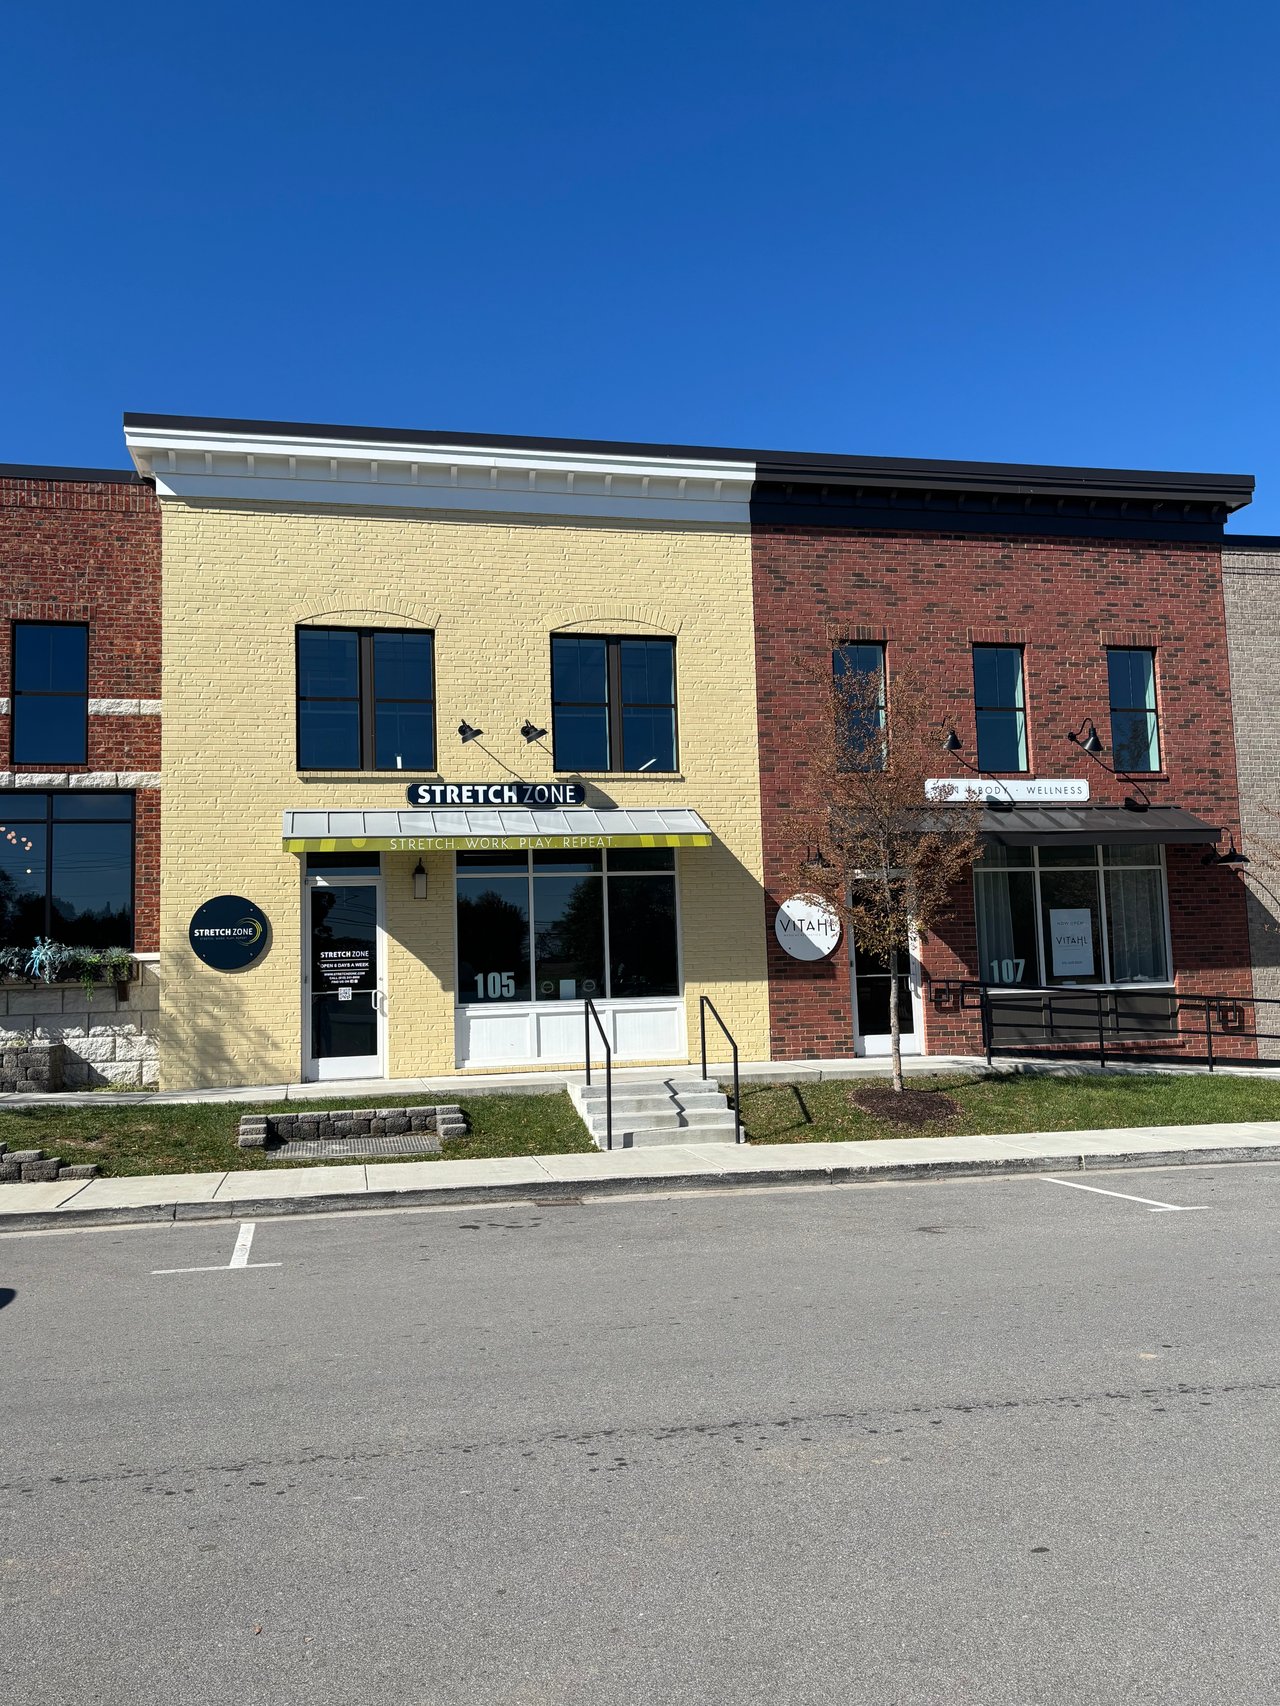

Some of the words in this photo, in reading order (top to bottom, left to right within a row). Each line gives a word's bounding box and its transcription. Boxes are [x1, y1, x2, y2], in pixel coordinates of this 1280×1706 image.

[417, 785, 518, 804] STRETCH
[522, 785, 577, 804] ZONE
[978, 786, 1009, 795] BODY
[1026, 786, 1083, 795] WELLNESS
[194, 928, 232, 937] STRETCH
[232, 927, 254, 936] ZONE
[779, 918, 836, 936] VITAHL
[1055, 936, 1088, 947] VITAHL
[990, 959, 1025, 984] 107
[474, 972, 515, 998] 105
